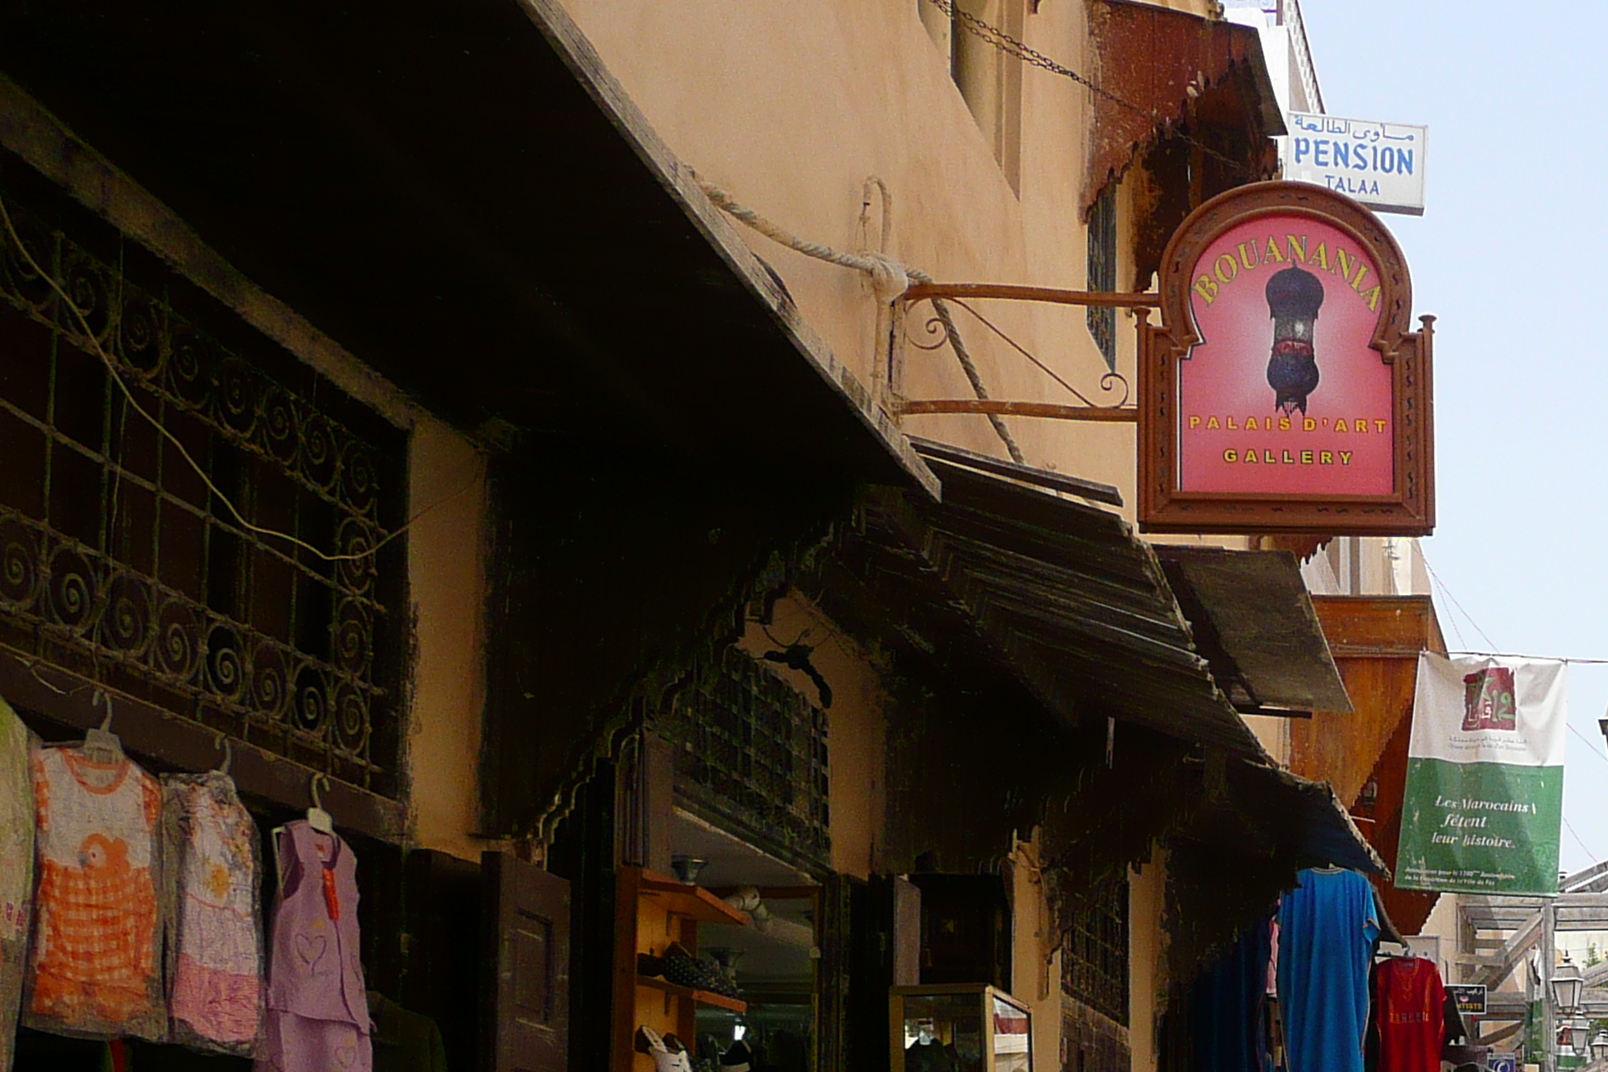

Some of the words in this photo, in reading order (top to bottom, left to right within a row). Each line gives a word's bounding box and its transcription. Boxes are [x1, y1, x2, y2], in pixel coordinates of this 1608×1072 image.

[1294, 136, 1413, 176] PENSION
[1325, 174, 1380, 195] TALAA
[1193, 234, 1383, 312] BOUANANIA
[1189, 415, 1291, 431] PALAIS
[1303, 418, 1388, 433] D'ART
[1223, 449, 1353, 465] GALLERY
[1435, 795, 1457, 808] Les
[1461, 798, 1530, 813] Marocains
[1440, 813, 1487, 828] fêtent
[1431, 832, 1459, 845] leur
